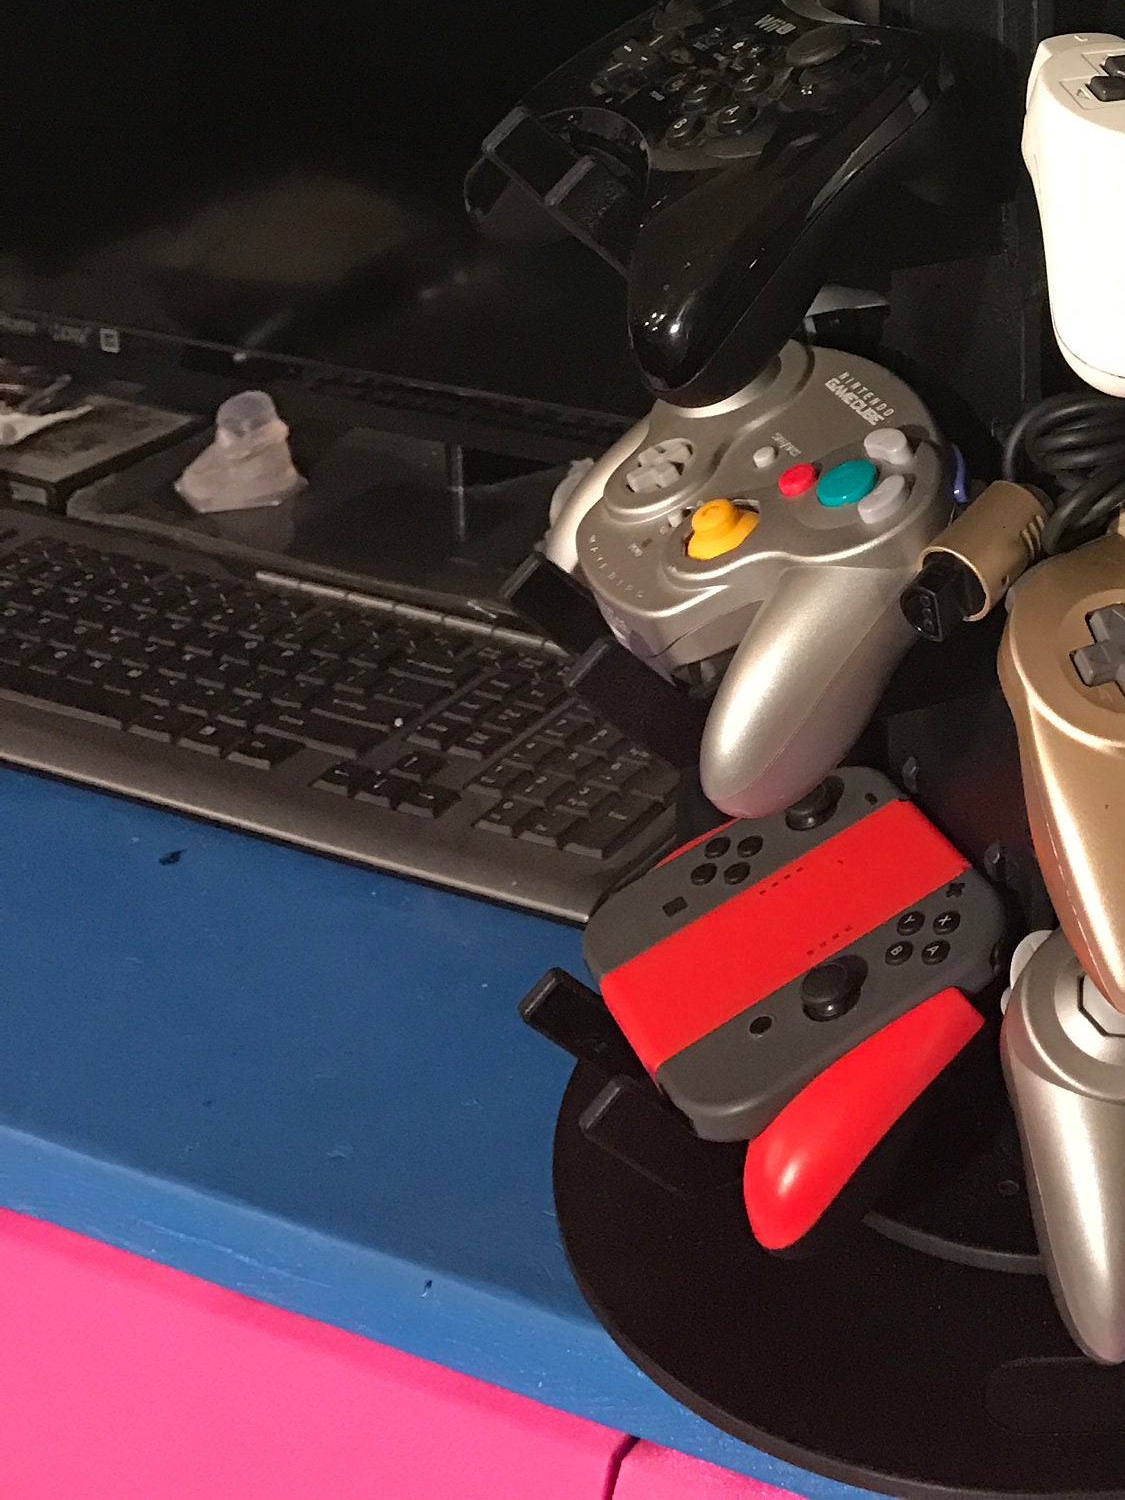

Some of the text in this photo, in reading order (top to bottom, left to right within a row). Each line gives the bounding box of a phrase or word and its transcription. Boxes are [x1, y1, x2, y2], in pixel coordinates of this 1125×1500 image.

[724, 105, 741, 116] A
[673, 117, 688, 129] B
[837, 371, 896, 417] NINTENDO
[824, 377, 885, 426] GAMECUBE
[903, 914, 952, 927] Y X
[890, 945, 940, 957] B A
